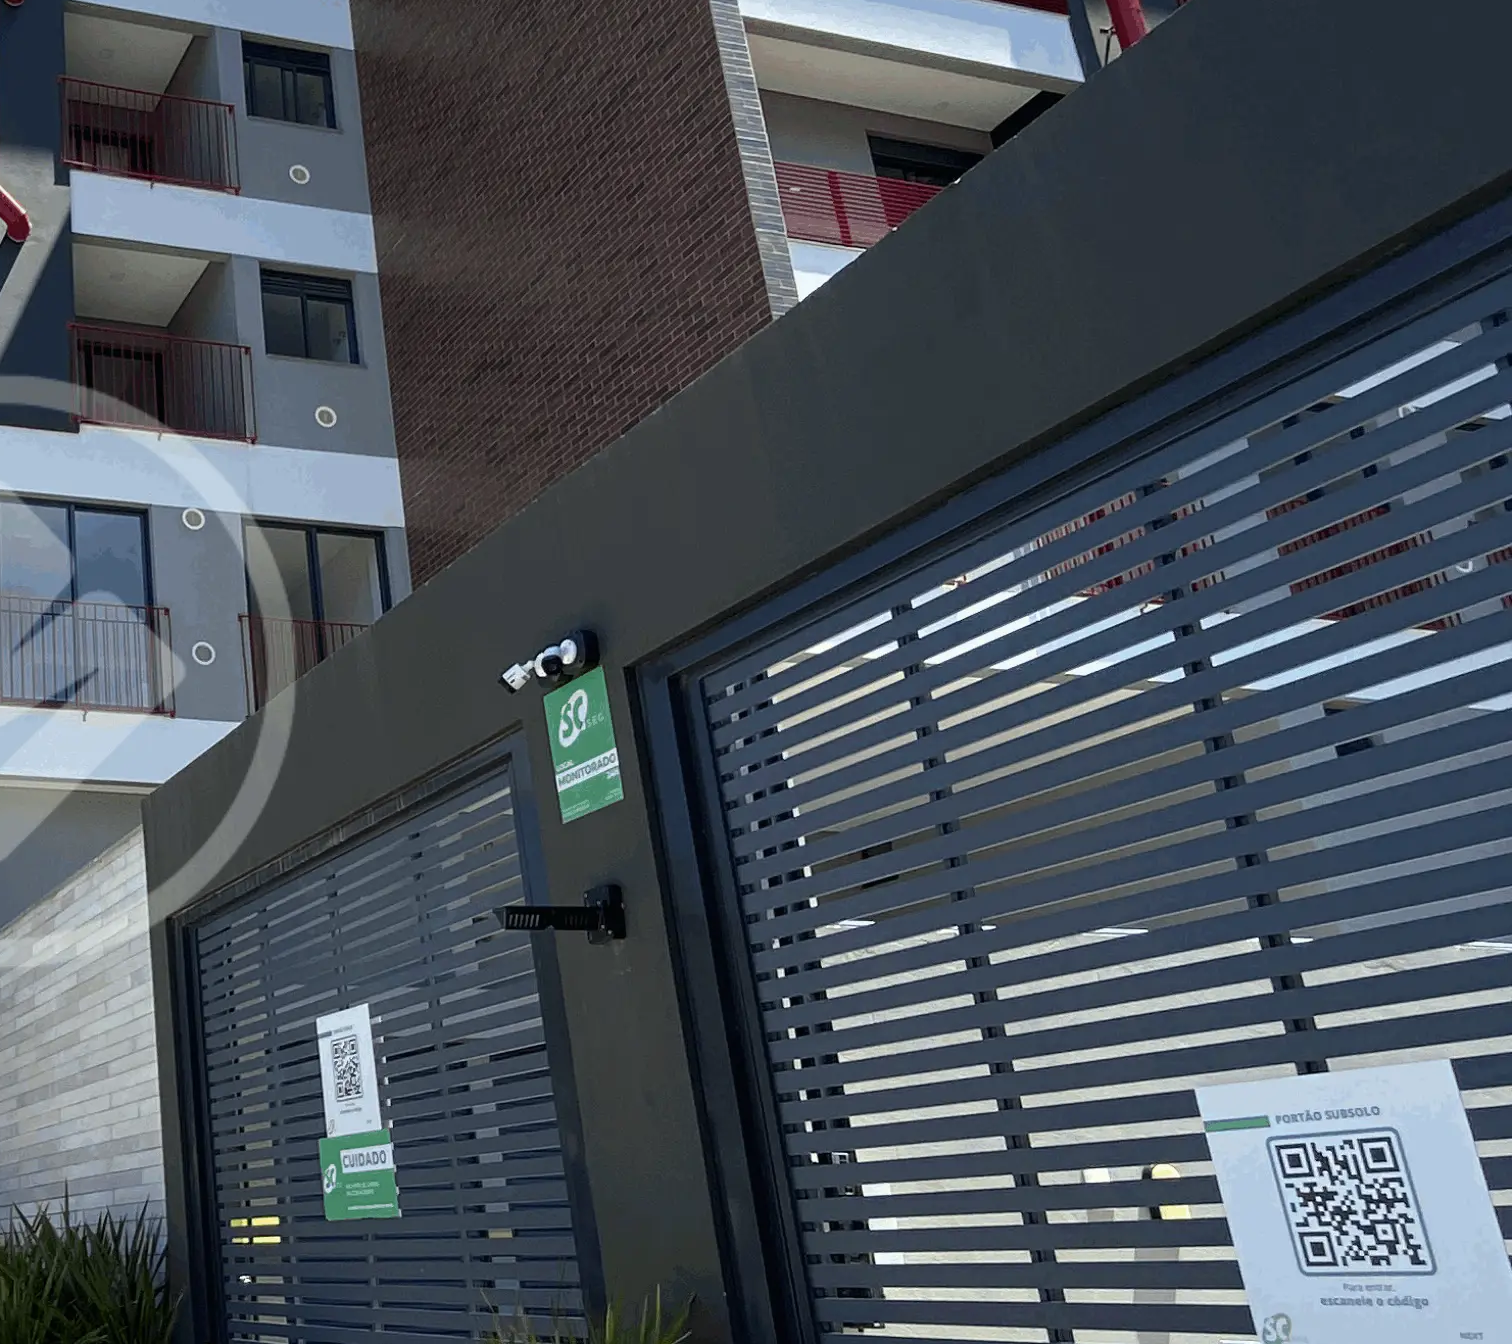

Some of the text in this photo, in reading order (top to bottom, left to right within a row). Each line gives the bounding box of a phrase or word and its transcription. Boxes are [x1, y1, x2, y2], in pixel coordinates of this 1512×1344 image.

[586, 712, 605, 728] SEG
[557, 752, 617, 787] MONITORADO
[1275, 1106, 1381, 1125] PORTÃO SUBSOLO
[342, 1150, 387, 1168] CUIDADO
[1376, 1298, 1384, 1306] o
[1387, 1295, 1429, 1309] código
